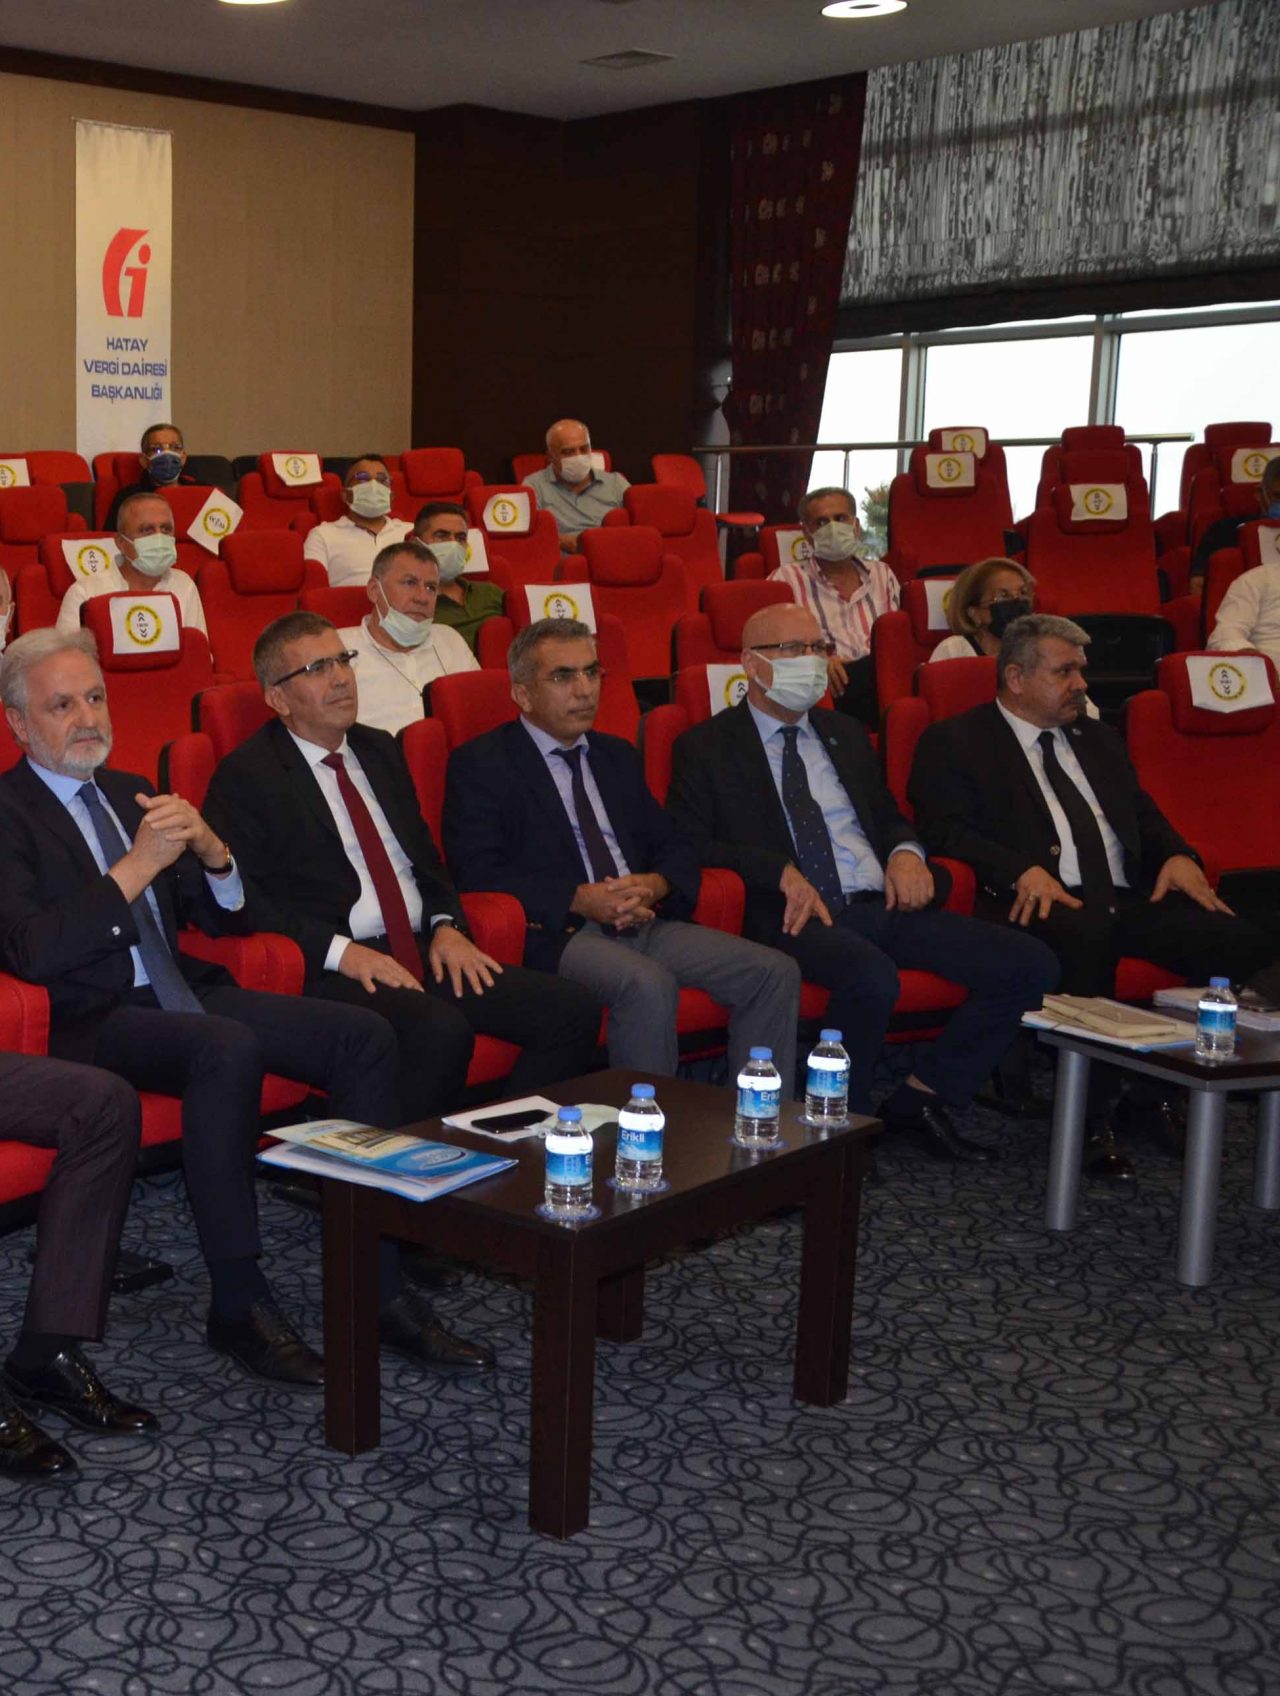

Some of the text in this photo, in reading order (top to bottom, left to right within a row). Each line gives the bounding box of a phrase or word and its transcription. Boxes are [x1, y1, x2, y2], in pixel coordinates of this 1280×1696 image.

[106, 337, 148, 352] HATAY
[83, 357, 167, 376] VERGİ DAİRESİ
[91, 382, 162, 404] BAŞKANLIĞI
